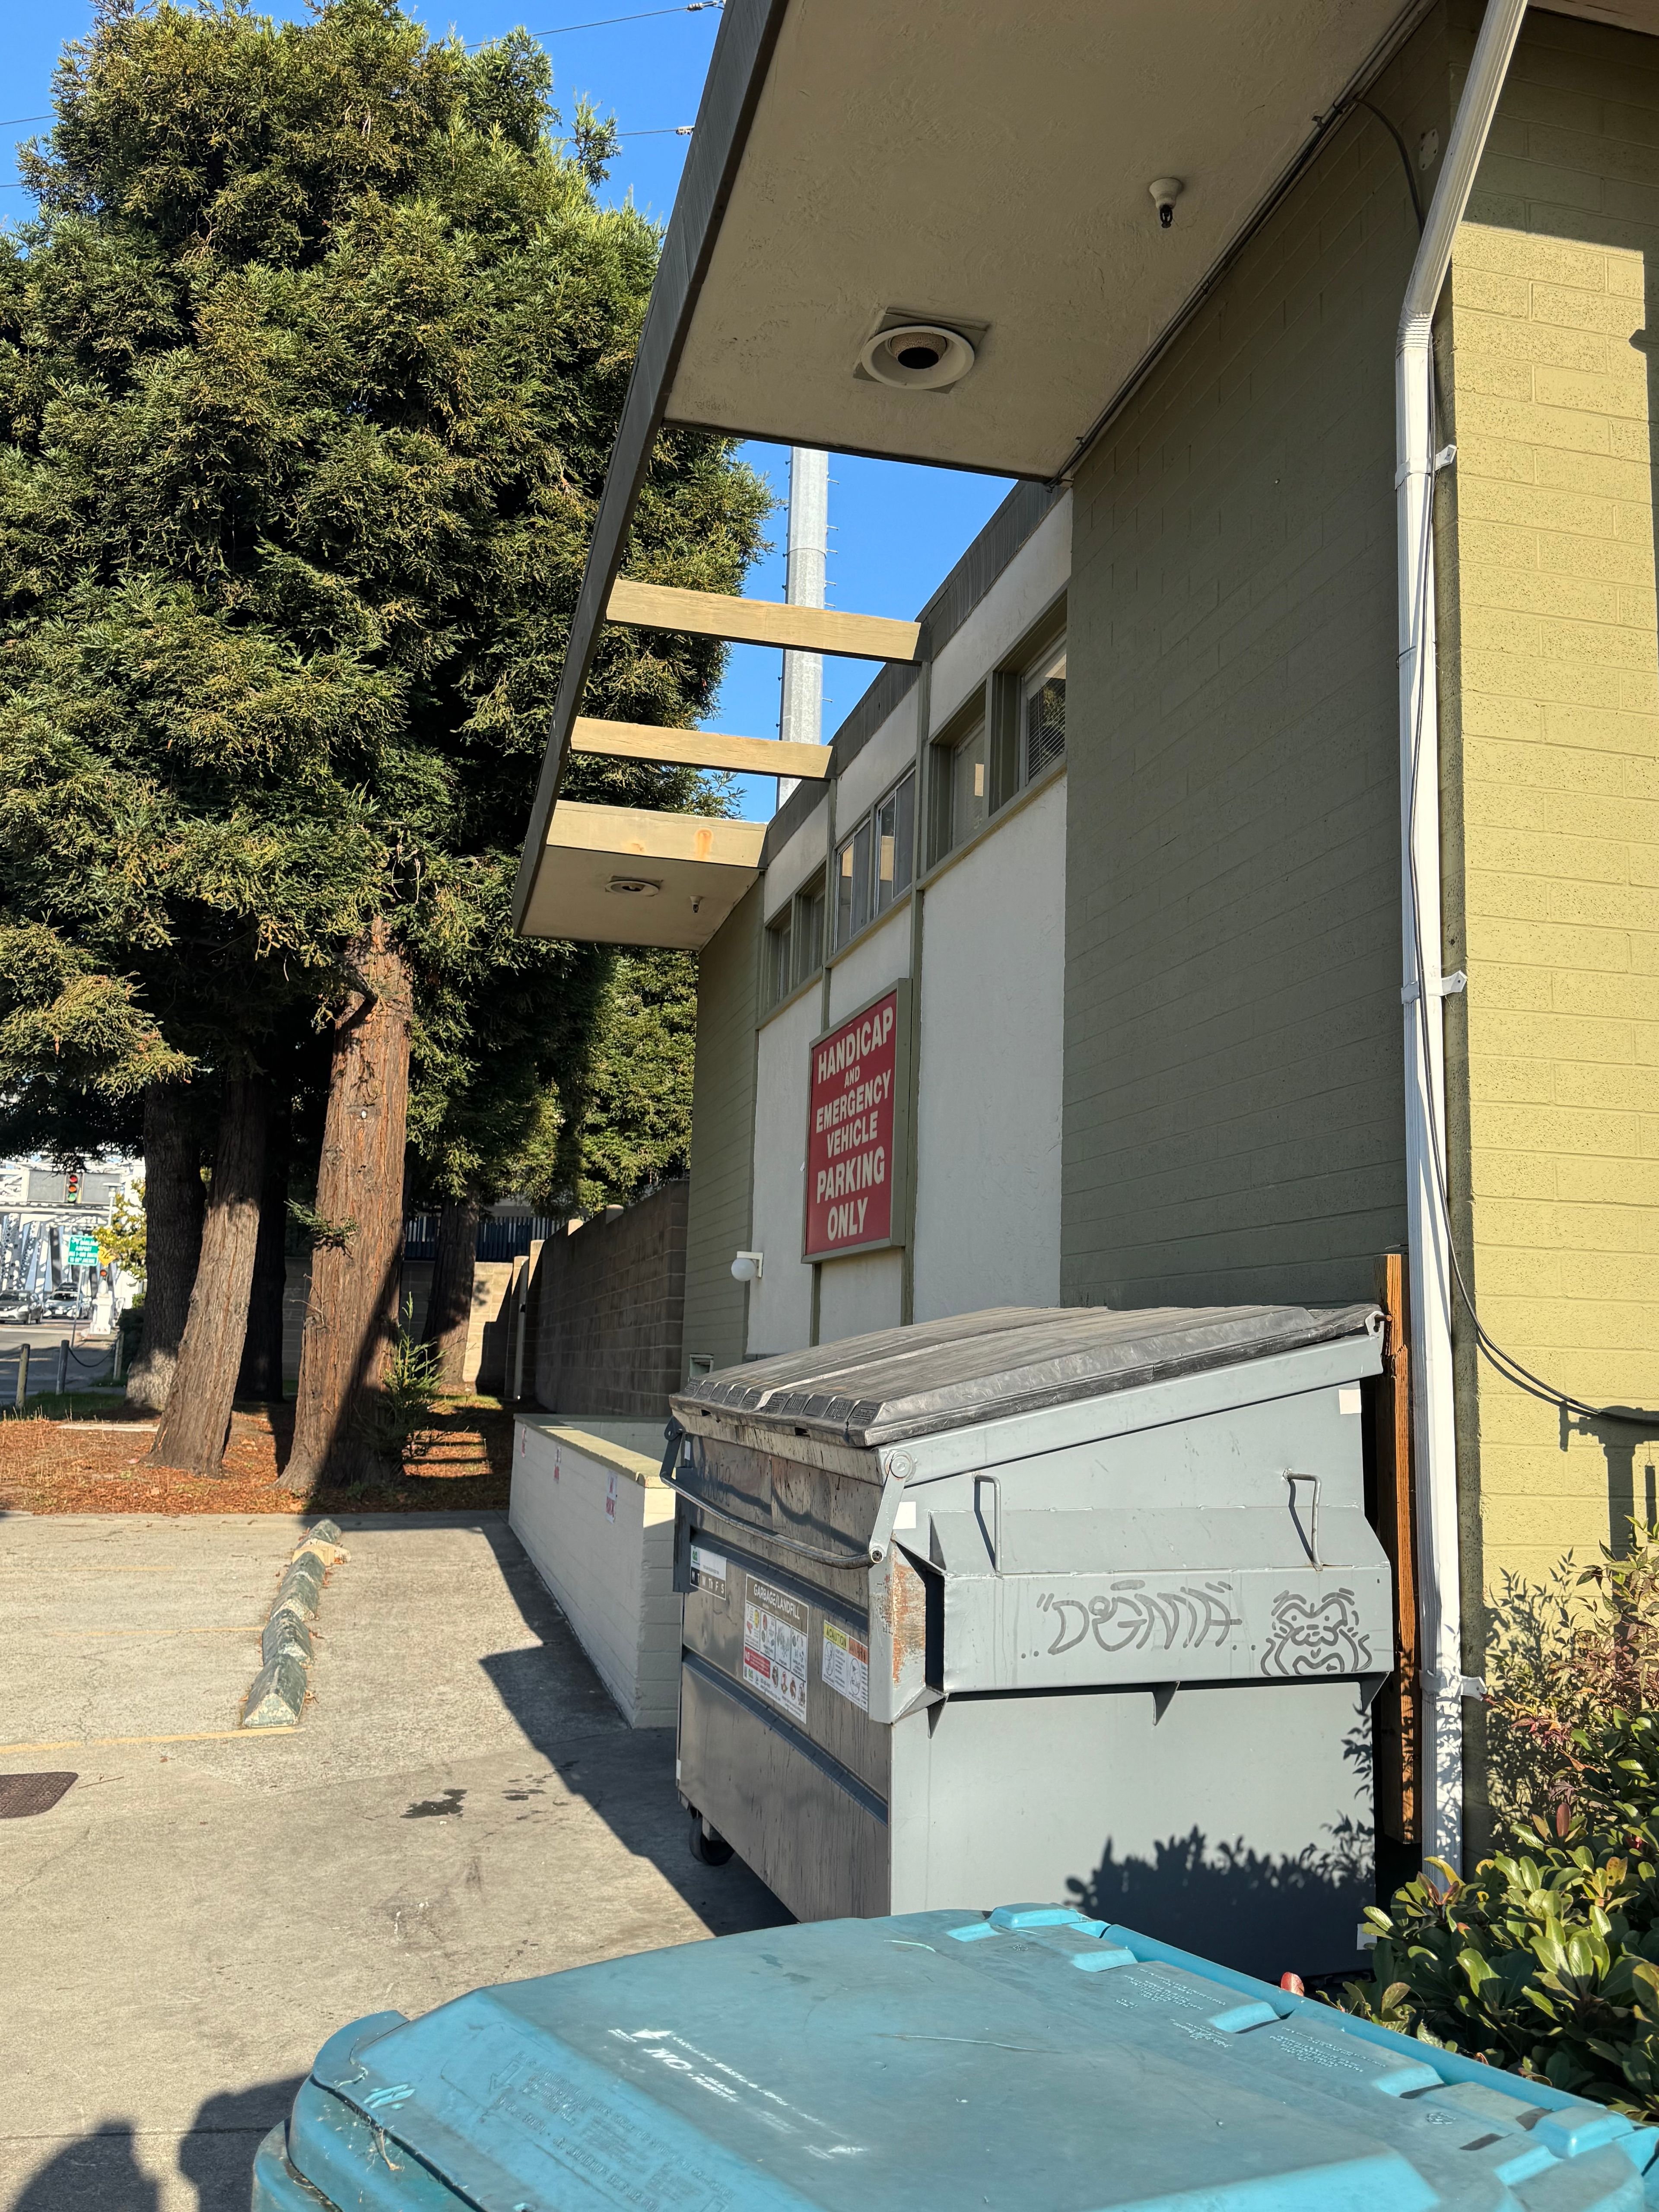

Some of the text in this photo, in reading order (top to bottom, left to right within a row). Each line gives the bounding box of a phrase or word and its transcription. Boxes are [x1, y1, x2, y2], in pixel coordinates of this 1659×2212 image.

[818, 1007, 893, 1084] HANDICAP
[844, 1065, 860, 1088] AND
[816, 1069, 891, 1133] EMERGENCY
[827, 1110, 878, 1158] VEHICLE
[817, 1146, 884, 1204] PARKING
[827, 1197, 868, 1241] ONLY
[702, 1575, 706, 1586] W
[709, 1578, 713, 1589] Th
[715, 1581, 718, 1591] F
[721, 1583, 724, 1594] S
[753, 1584, 800, 1620] GARBAGE/LANDFILL
[829, 1628, 846, 1649] CAUTION
[643, 2048, 693, 2070] NO
